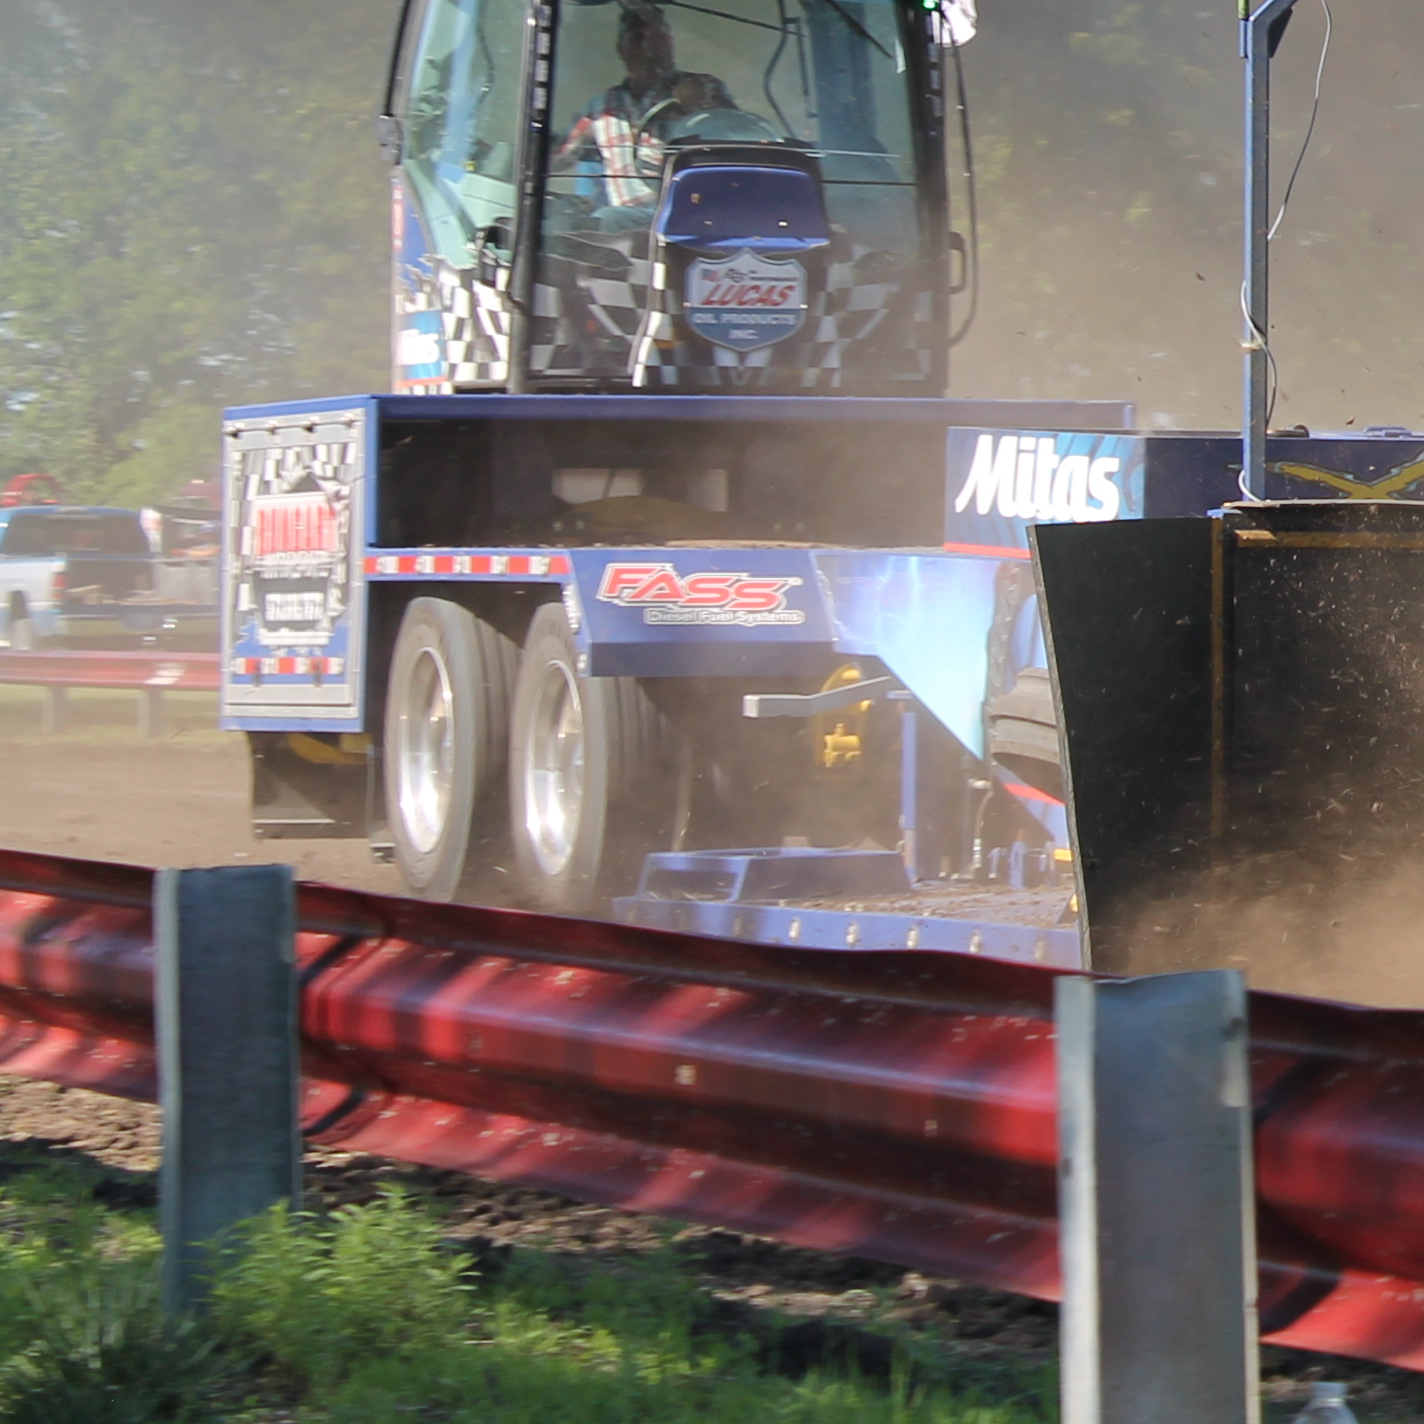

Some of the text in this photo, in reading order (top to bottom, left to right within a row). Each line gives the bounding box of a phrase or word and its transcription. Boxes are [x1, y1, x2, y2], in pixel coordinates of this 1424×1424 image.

[701, 284, 797, 307] LUCAS
[693, 312, 797, 325] OIL PRODUCTS
[953, 433, 1121, 522] Mitas
[599, 563, 790, 613] FASS
[648, 609, 696, 623] Diesel
[699, 609, 734, 623] Fuel
